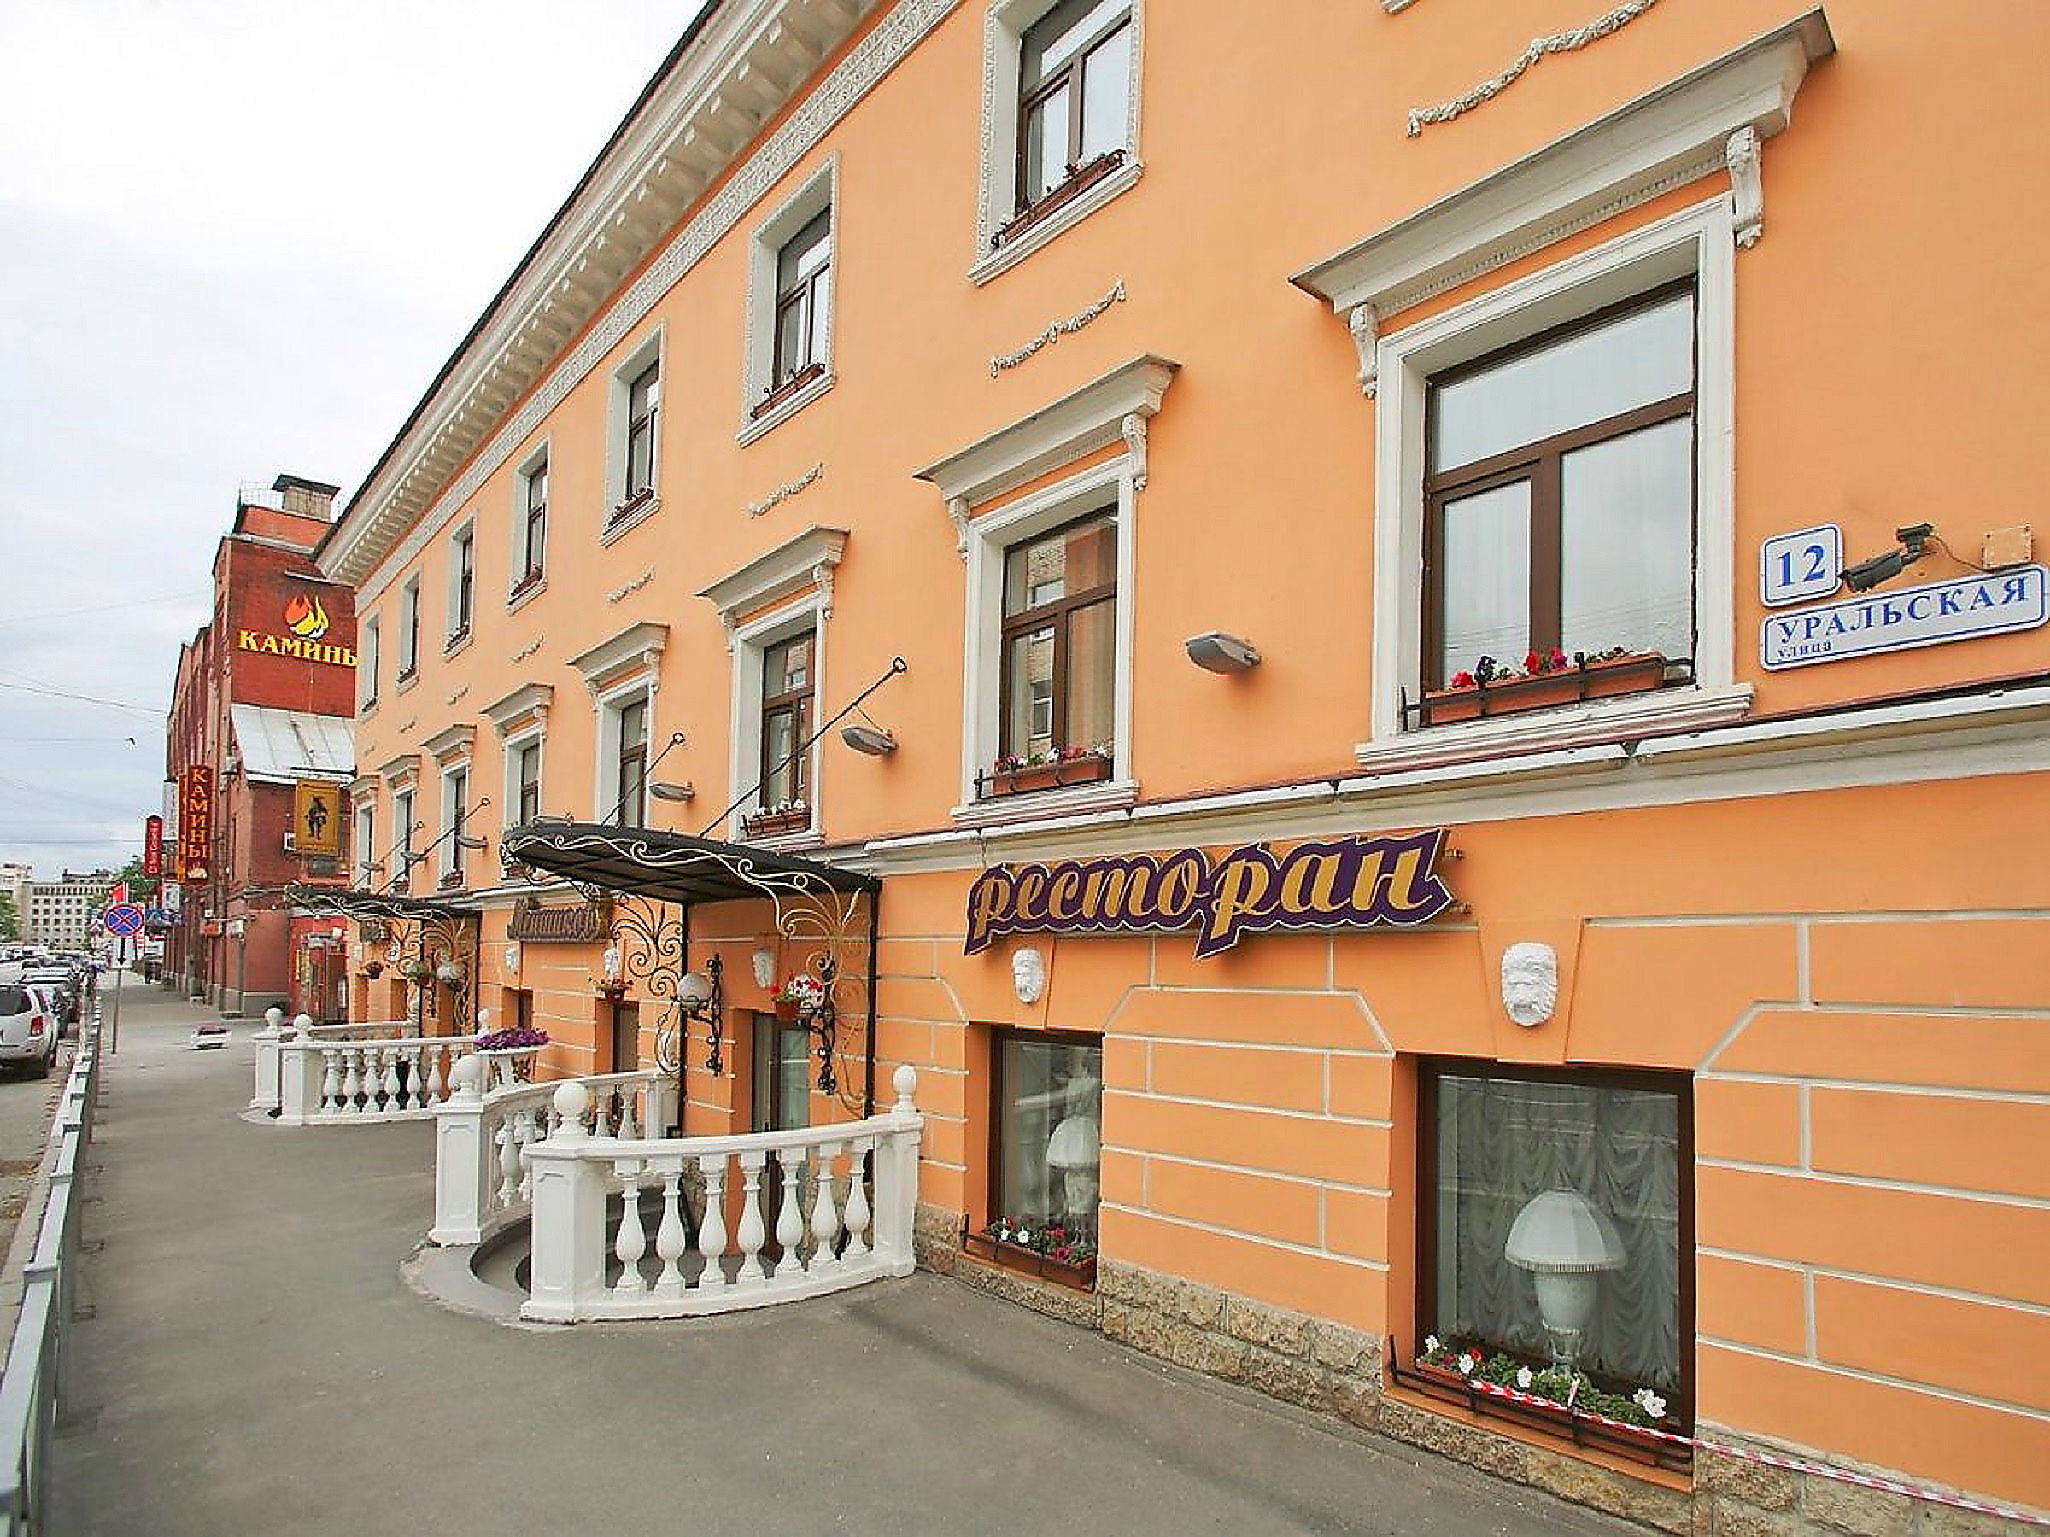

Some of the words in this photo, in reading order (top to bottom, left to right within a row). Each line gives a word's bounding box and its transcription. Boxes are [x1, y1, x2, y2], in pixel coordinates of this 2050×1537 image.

[1776, 545, 1826, 588] 12
[1778, 577, 2028, 643] УРАЛЬСКАЯ
[1777, 641, 1833, 661] улица
[190, 769, 209, 858] КАМИНЫ
[972, 846, 1430, 940] ресторан
